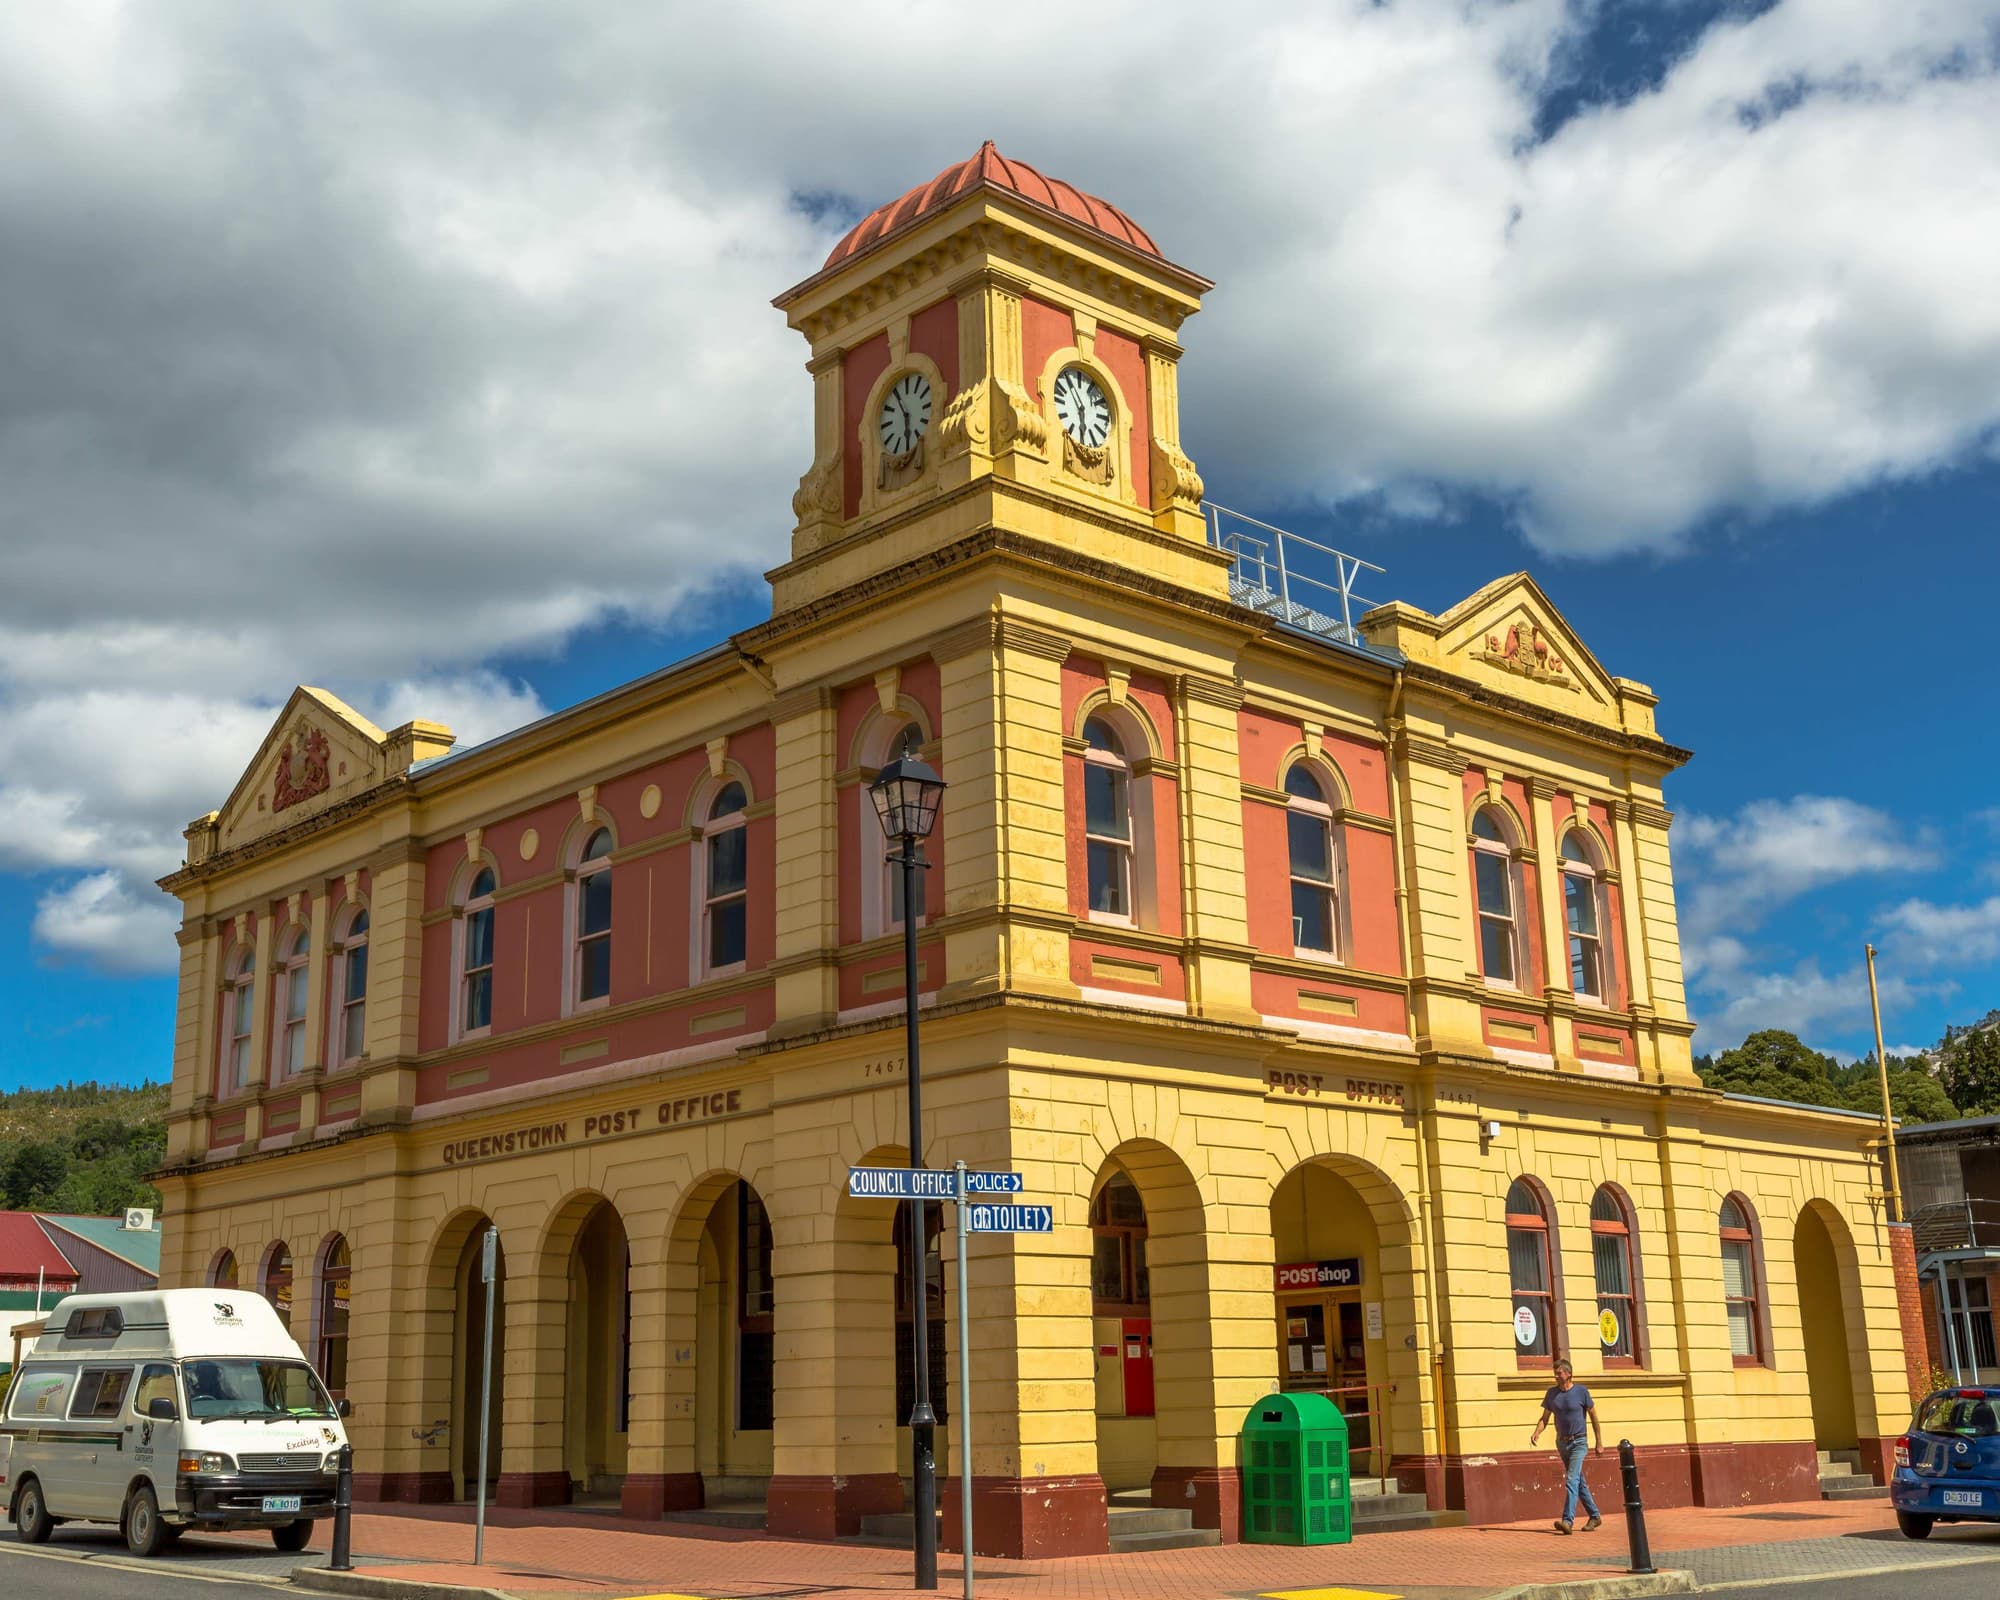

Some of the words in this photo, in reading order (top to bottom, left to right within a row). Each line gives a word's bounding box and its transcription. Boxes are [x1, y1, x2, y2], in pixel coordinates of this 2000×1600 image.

[338, 761, 347, 777] R
[864, 1057, 905, 1077] 7467
[1268, 1070, 1324, 1098] POST
[1346, 1079, 1406, 1106] OFFICE
[1439, 1091, 1473, 1105] 7467
[443, 1121, 568, 1165] QUEENSTOWN
[584, 1108, 641, 1138] POST
[658, 1089, 742, 1124] OFFICE
[853, 1171, 907, 1193] COUNCIL
[912, 1172, 954, 1195] OFFICE
[967, 1174, 1011, 1191] POLICE
[991, 1206, 1042, 1230] TOILET
[1279, 1266, 1351, 1285] POSTshop
[286, 1437, 320, 1450] Exciting
[264, 1499, 275, 1510] FN
